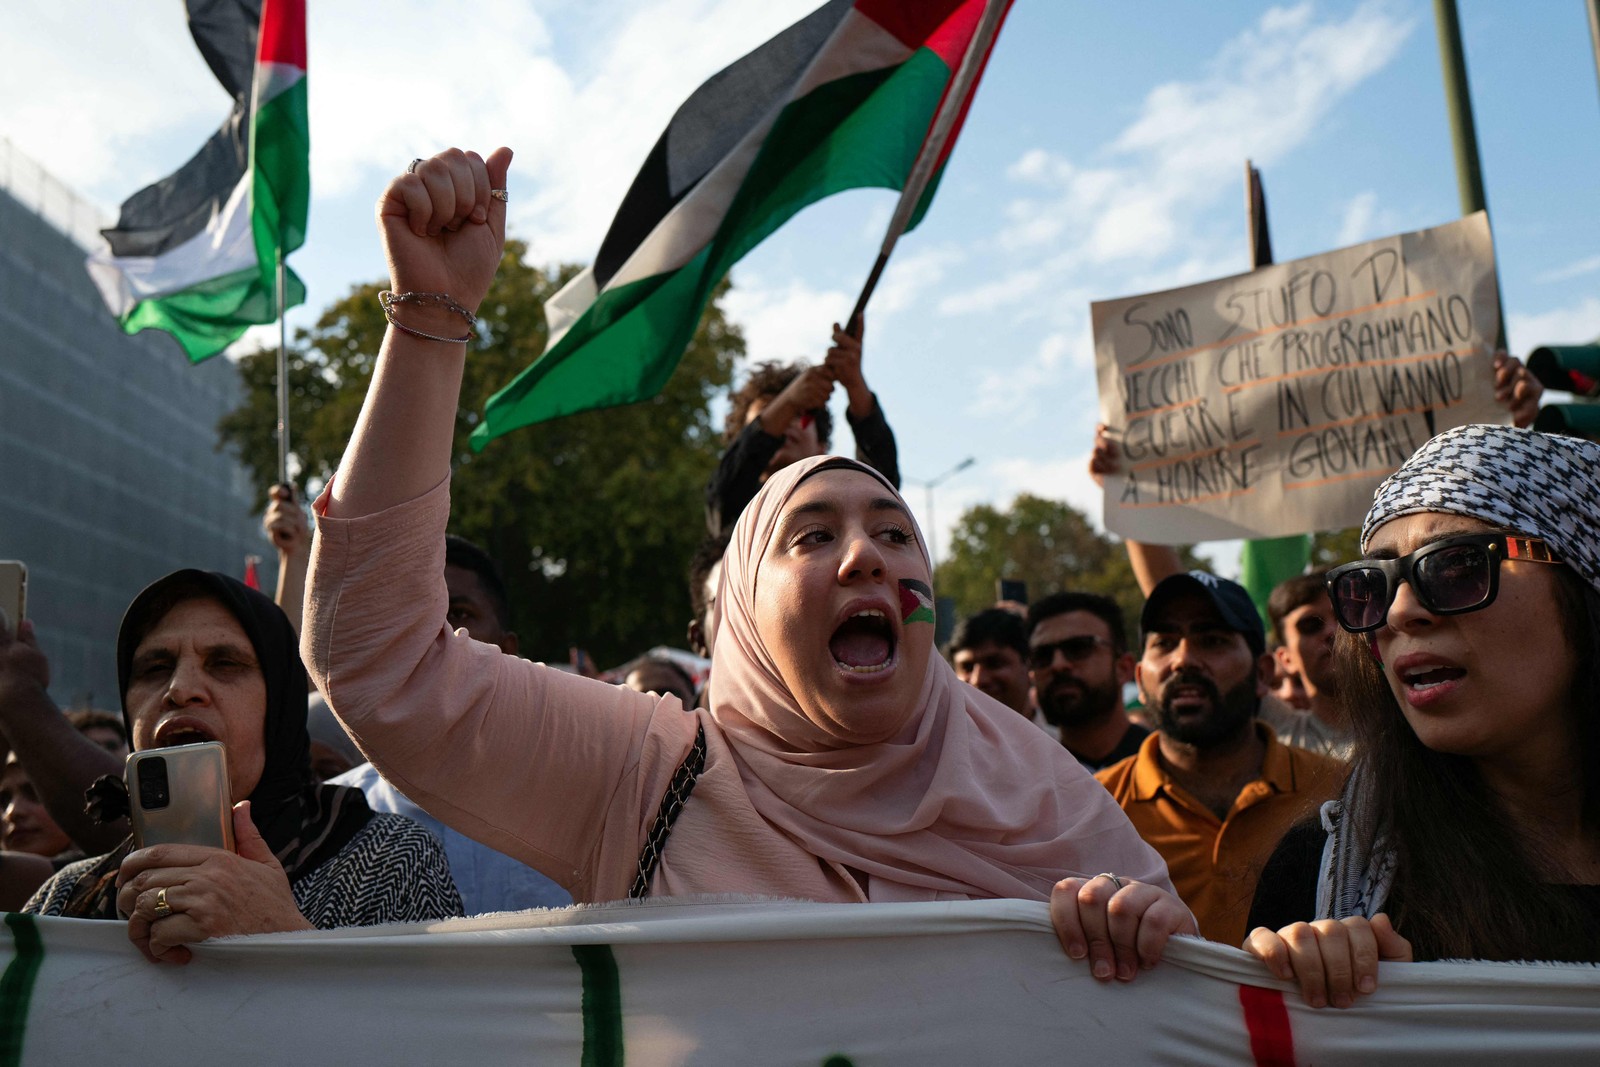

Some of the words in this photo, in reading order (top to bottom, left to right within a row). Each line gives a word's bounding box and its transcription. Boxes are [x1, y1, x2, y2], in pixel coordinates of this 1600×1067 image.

[1218, 270, 1336, 344] STUFO
[1352, 248, 1410, 303] DI
[1218, 340, 1270, 387] CHE
[1270, 294, 1472, 375] PROGRAMMANO
[1122, 388, 1255, 461] GUERRE
[1277, 376, 1310, 431] IN
[1321, 368, 1367, 421] CUI
[1370, 351, 1462, 415] VANNO
[1120, 470, 1140, 505] A
